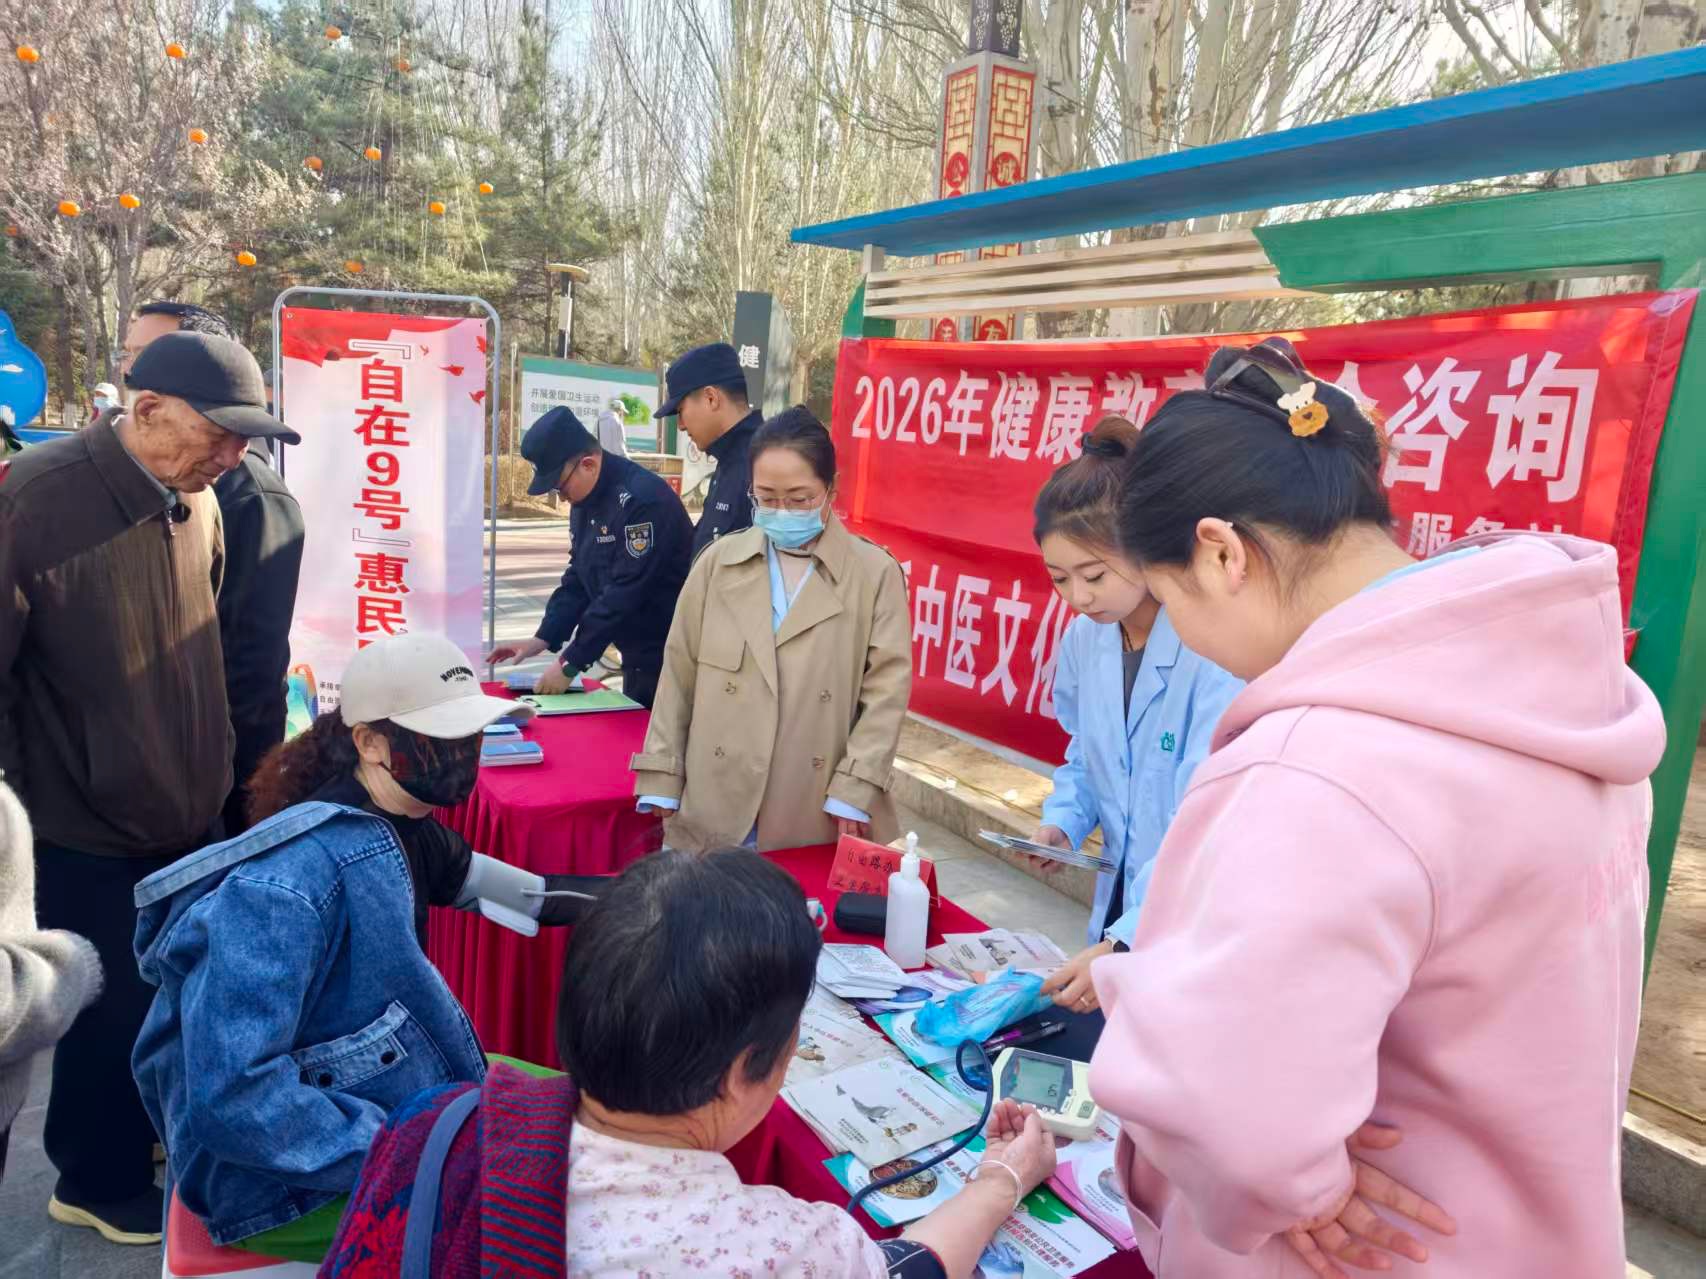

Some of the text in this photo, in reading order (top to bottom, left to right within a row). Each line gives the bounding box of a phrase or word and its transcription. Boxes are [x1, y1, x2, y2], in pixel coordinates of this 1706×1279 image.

[739, 344, 760, 368] 健
[851, 351, 1599, 503] 2026年健康教咨询
[351, 340, 411, 649] 『自在9号』惠民
[901, 559, 1072, 719] 中医文化
